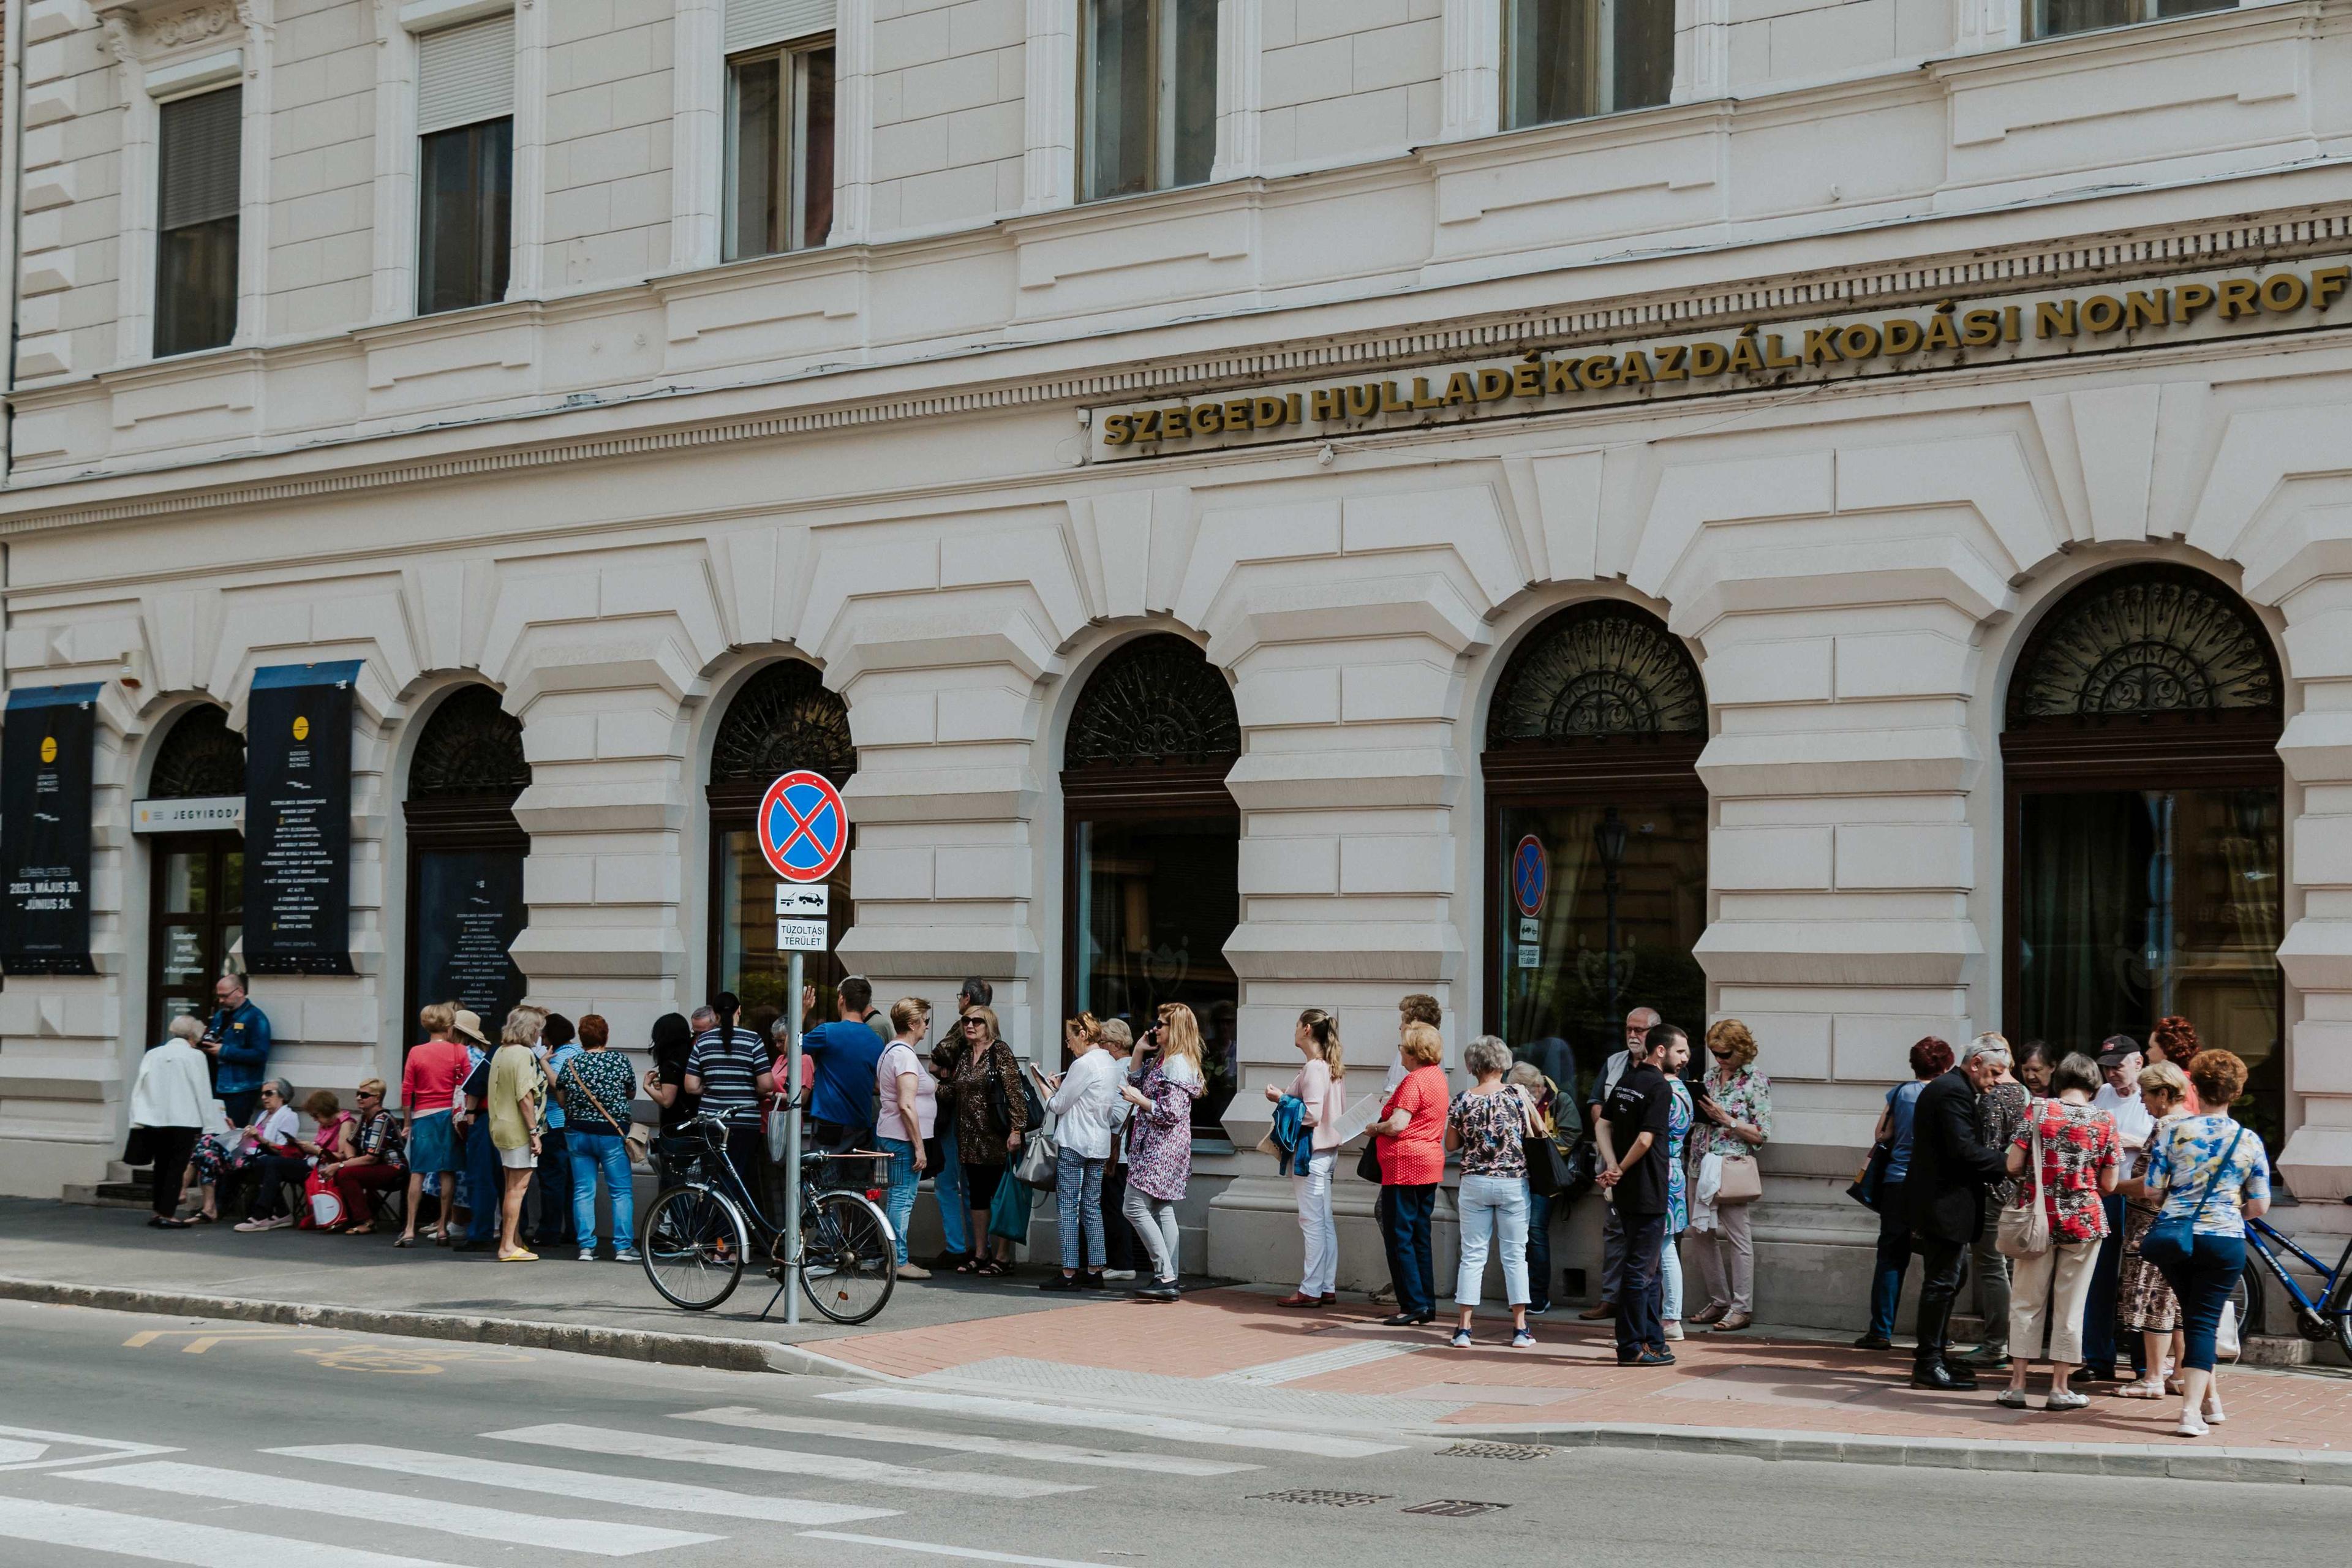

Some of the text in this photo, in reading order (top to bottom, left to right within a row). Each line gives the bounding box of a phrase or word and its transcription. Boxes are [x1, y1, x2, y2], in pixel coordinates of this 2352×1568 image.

[1104, 265, 2351, 445] SZEGEDI HULLADÉKGAZDÁLKODÁSI NONPROF
[35, 880, 66, 893] MÁJUS
[67, 881, 81, 892] 30.
[59, 899, 74, 909] 24.
[781, 924, 824, 935] TŰZOLTÁSI
[785, 936, 821, 946] TERÜLET
